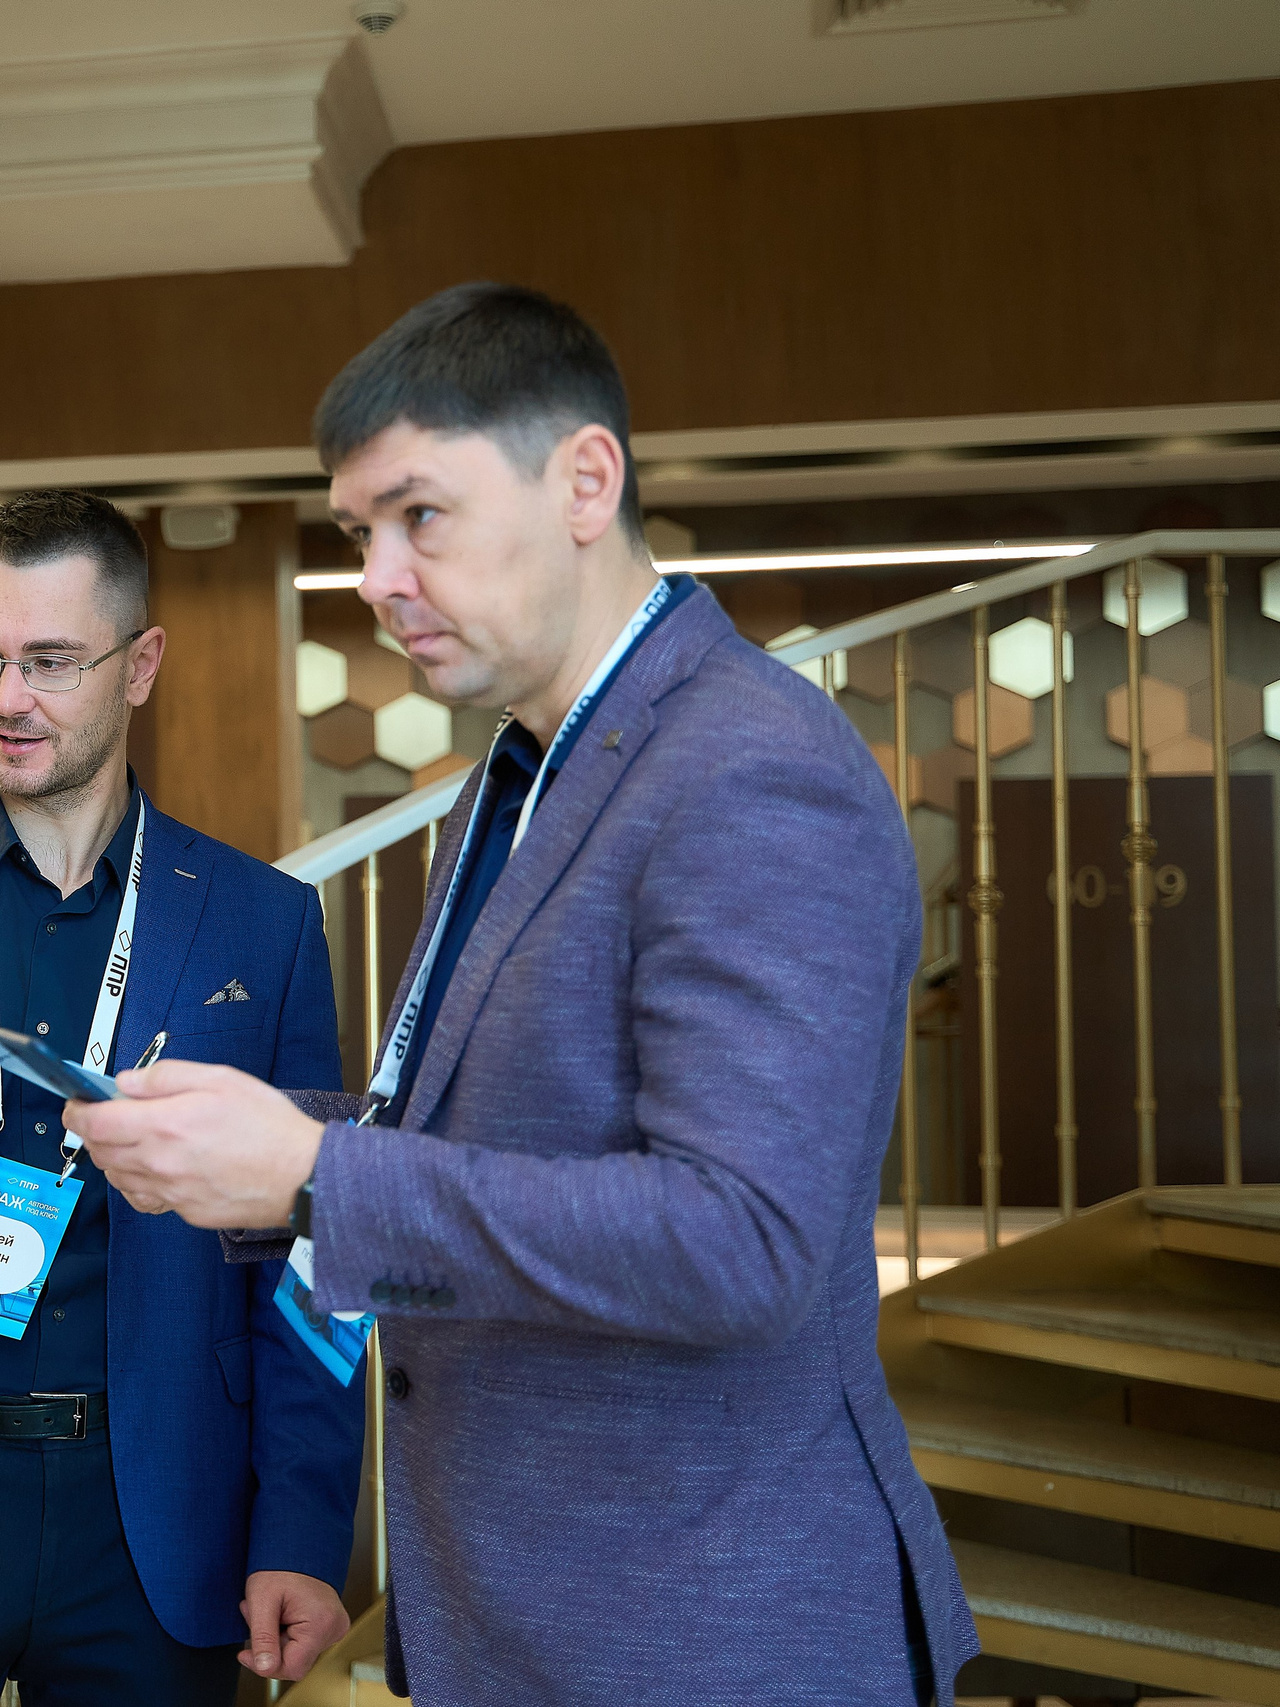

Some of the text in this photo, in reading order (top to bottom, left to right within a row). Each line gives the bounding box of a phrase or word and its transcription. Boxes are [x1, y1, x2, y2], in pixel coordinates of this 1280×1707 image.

[106, 953, 128, 998] ППР
[394, 1002, 418, 1060] ППР
[19, 1179, 40, 1191] ППР
[25, 1206, 59, 1221] ПОД КЛЮЧ
[27, 1200, 61, 1214] АВТОПАРК
